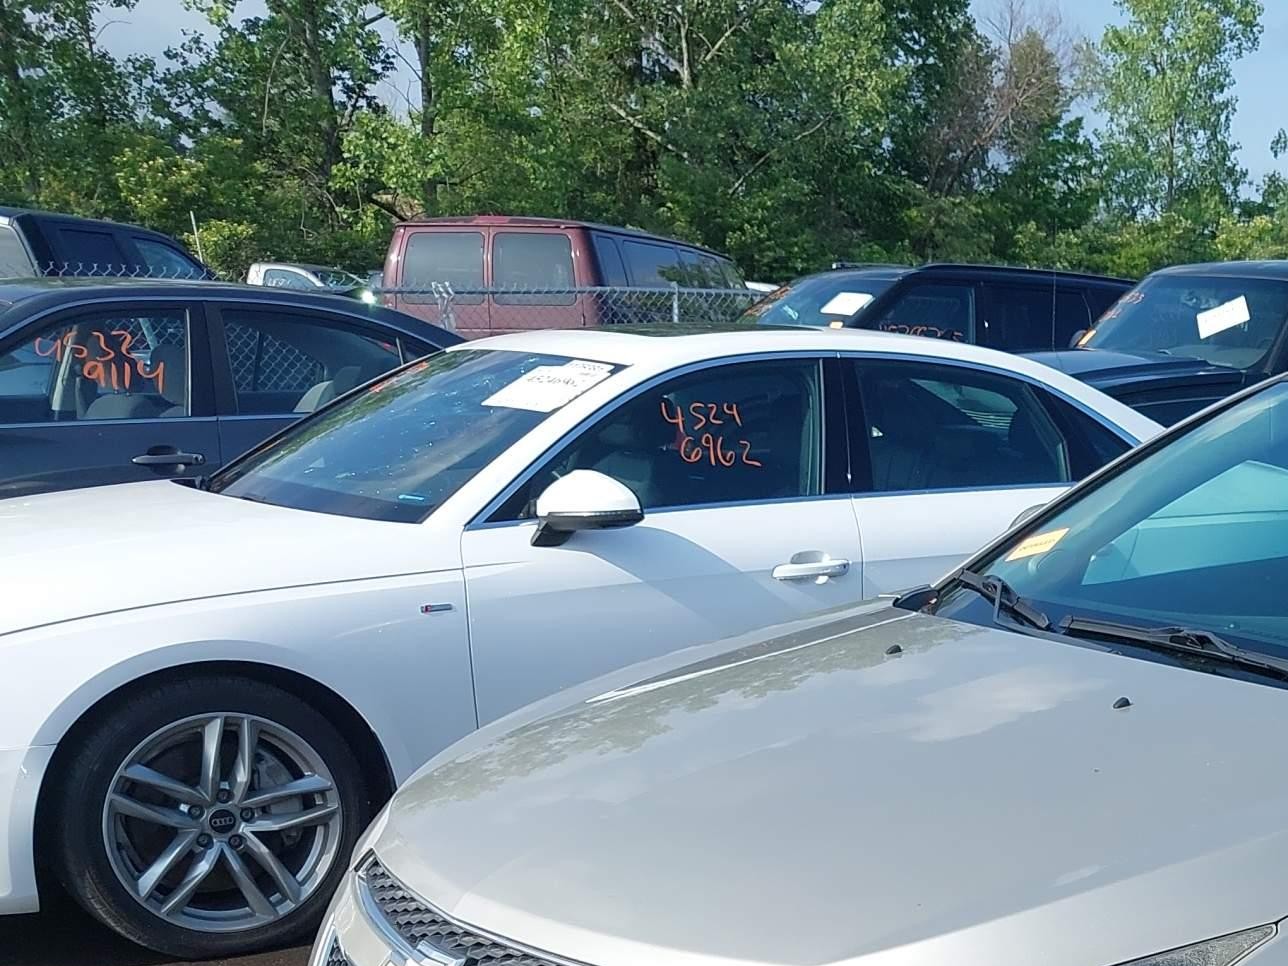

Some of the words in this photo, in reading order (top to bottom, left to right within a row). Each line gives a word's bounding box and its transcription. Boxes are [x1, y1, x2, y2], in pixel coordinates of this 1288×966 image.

[34, 331, 137, 362] 4532
[83, 361, 164, 395] 9114
[661, 403, 742, 432] 4524
[681, 433, 762, 467] 6962
